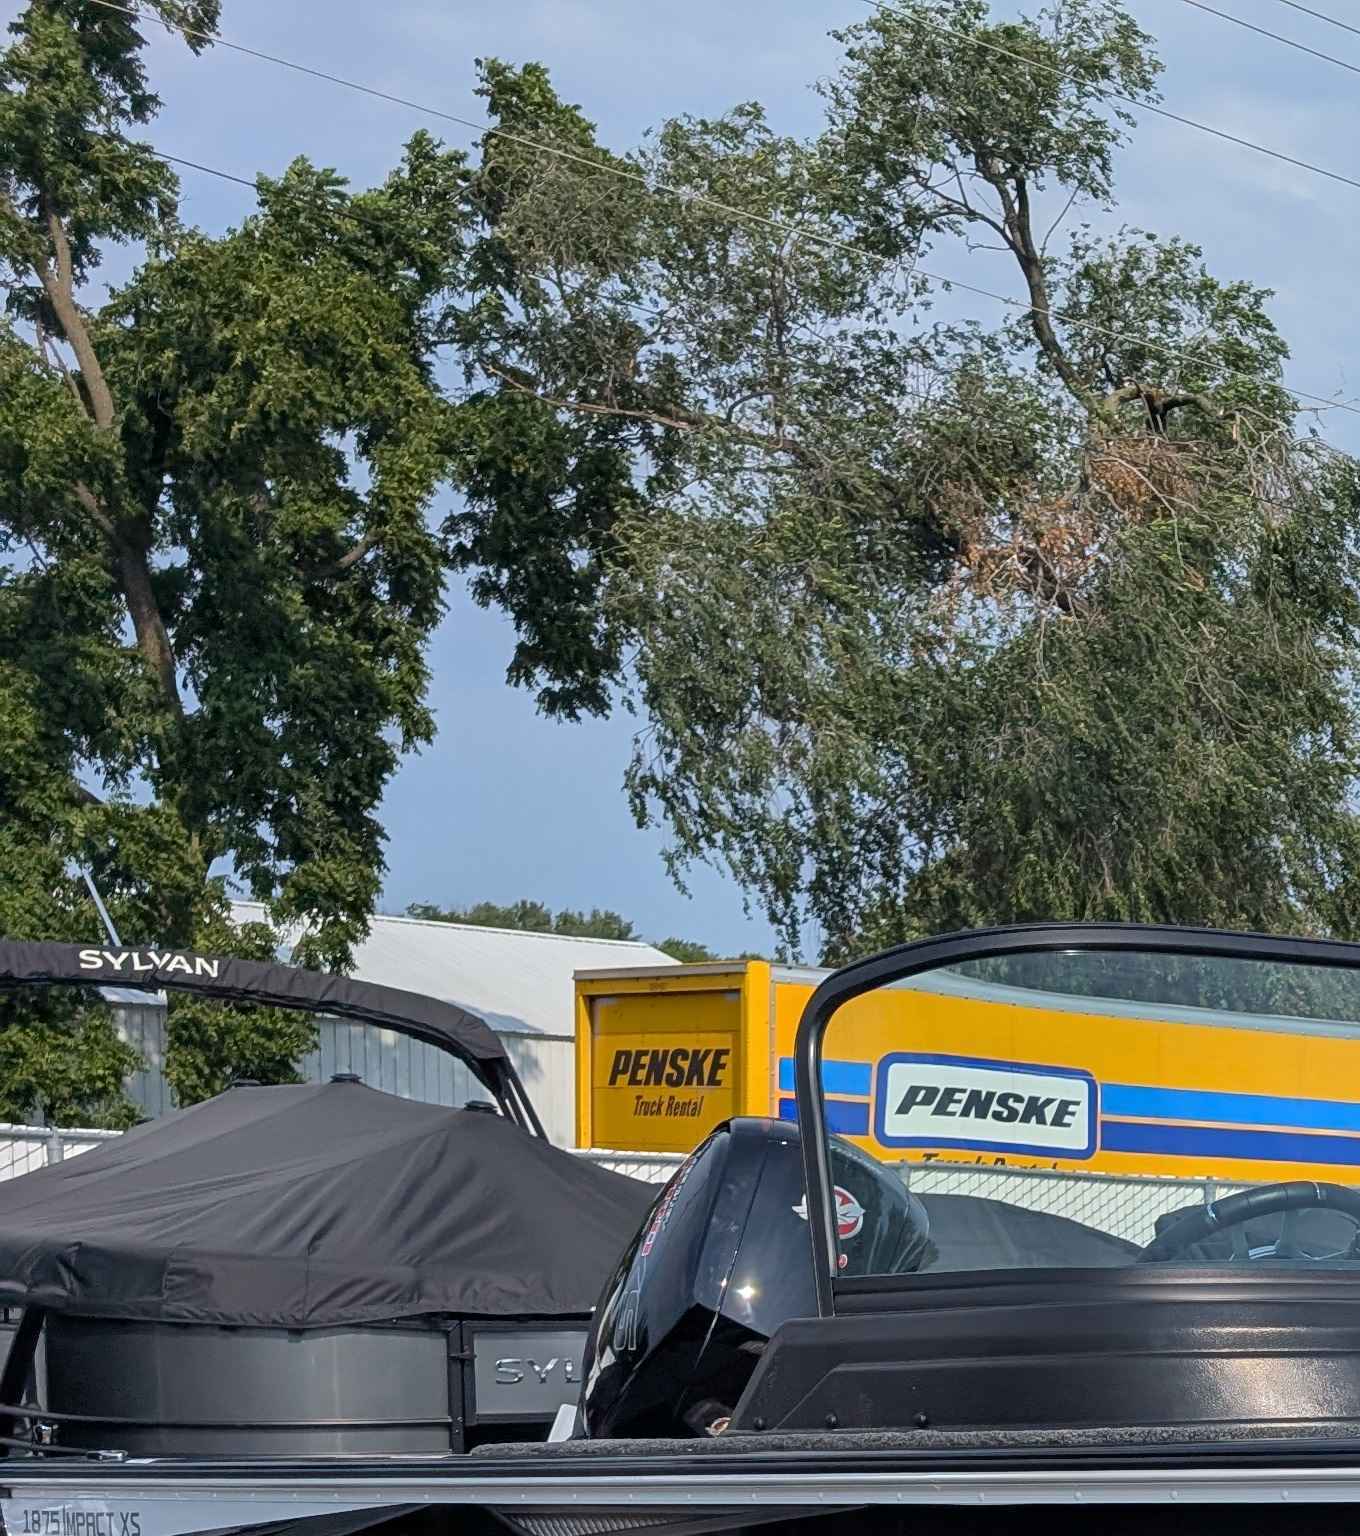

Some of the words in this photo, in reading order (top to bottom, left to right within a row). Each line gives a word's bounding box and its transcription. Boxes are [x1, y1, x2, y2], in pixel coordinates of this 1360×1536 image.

[79, 949, 219, 978] SYLVAN
[608, 1048, 731, 1088] PENSKE
[633, 1095, 664, 1117] Truck
[665, 1095, 705, 1118] Rental
[895, 1085, 1082, 1128] PENSKE
[495, 1358, 582, 1384] SYL
[23, 1509, 60, 1535] 1875
[61, 1506, 115, 1536] IMPACT
[119, 1511, 141, 1536] XS
